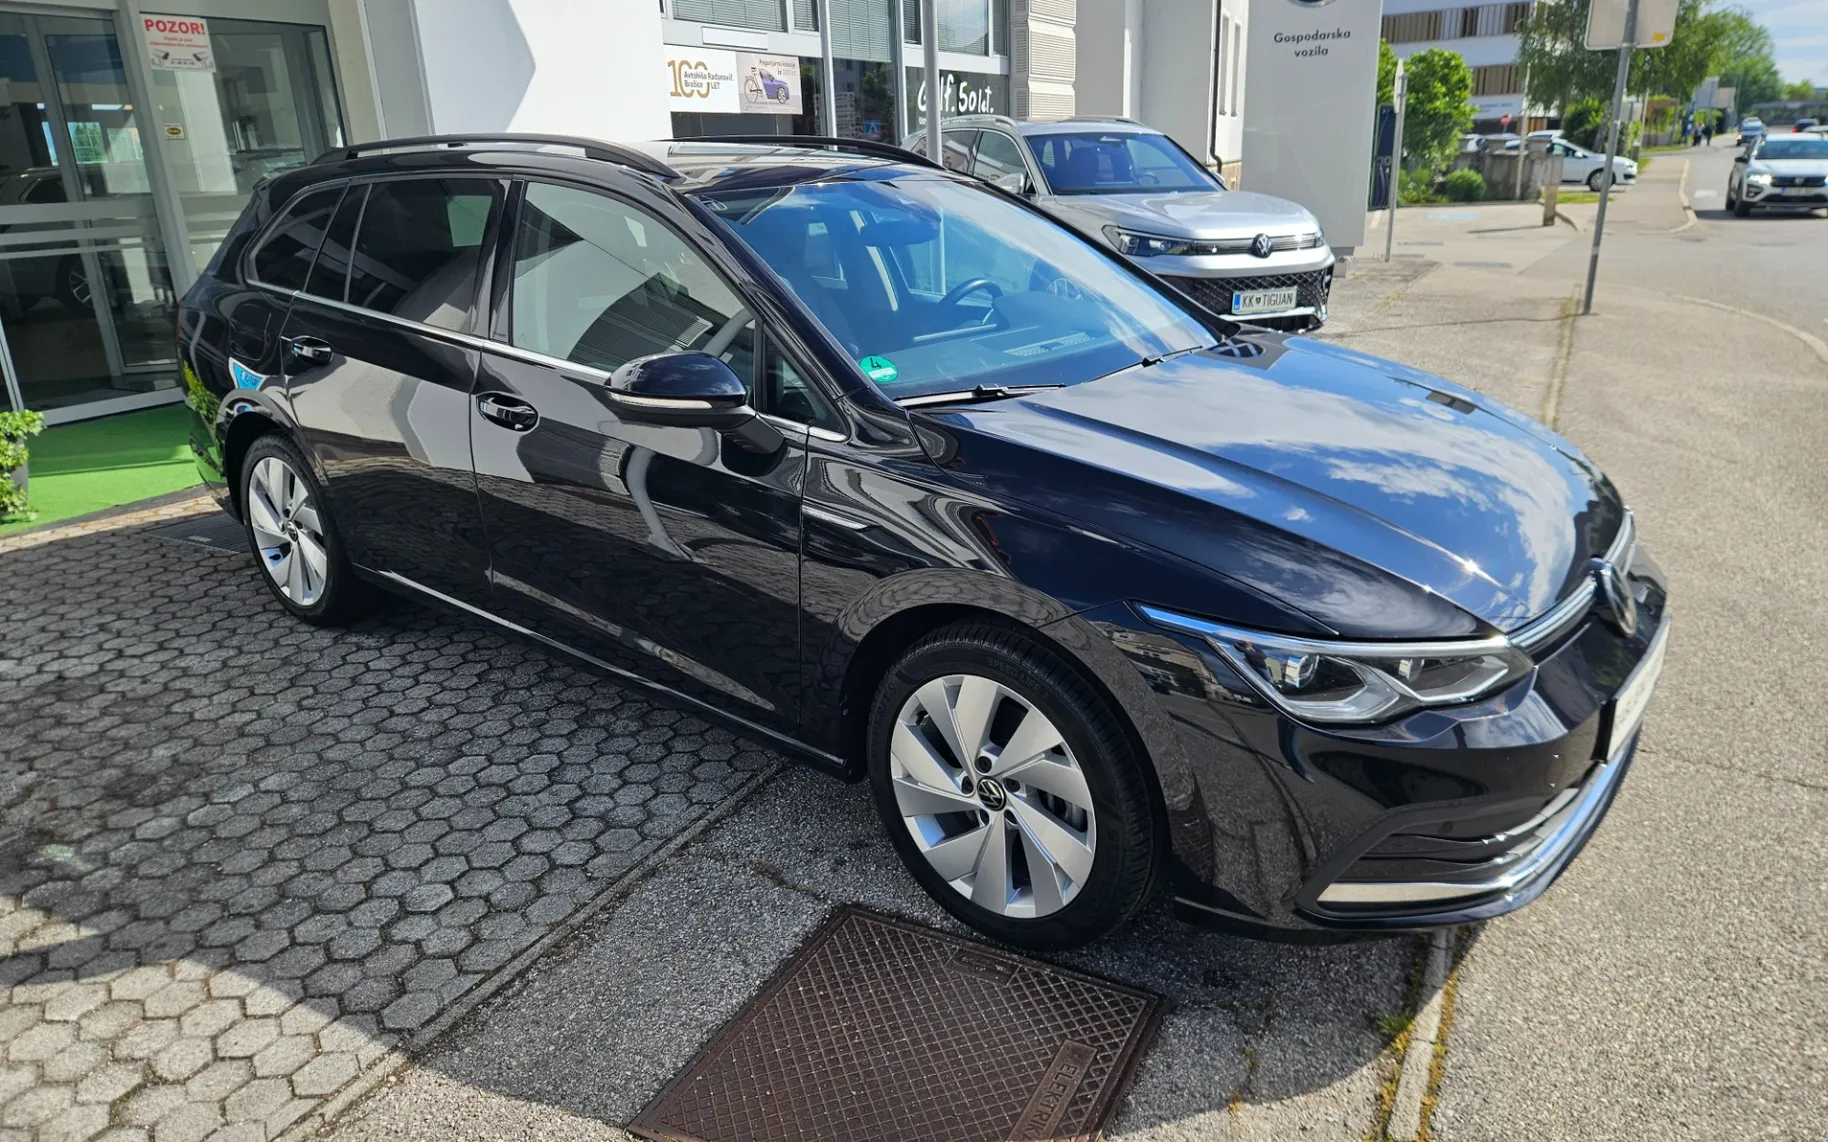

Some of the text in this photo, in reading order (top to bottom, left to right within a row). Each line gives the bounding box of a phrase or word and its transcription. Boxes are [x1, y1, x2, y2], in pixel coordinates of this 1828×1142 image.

[144, 18, 206, 35] POZOR!
[1273, 27, 1351, 44] Gospodarska
[1294, 44, 1329, 58] vozila
[711, 81, 720, 89] LET
[917, 73, 955, 113] Glf.
[1242, 292, 1293, 308] KK TIGUAN
[869, 357, 882, 369] 4
